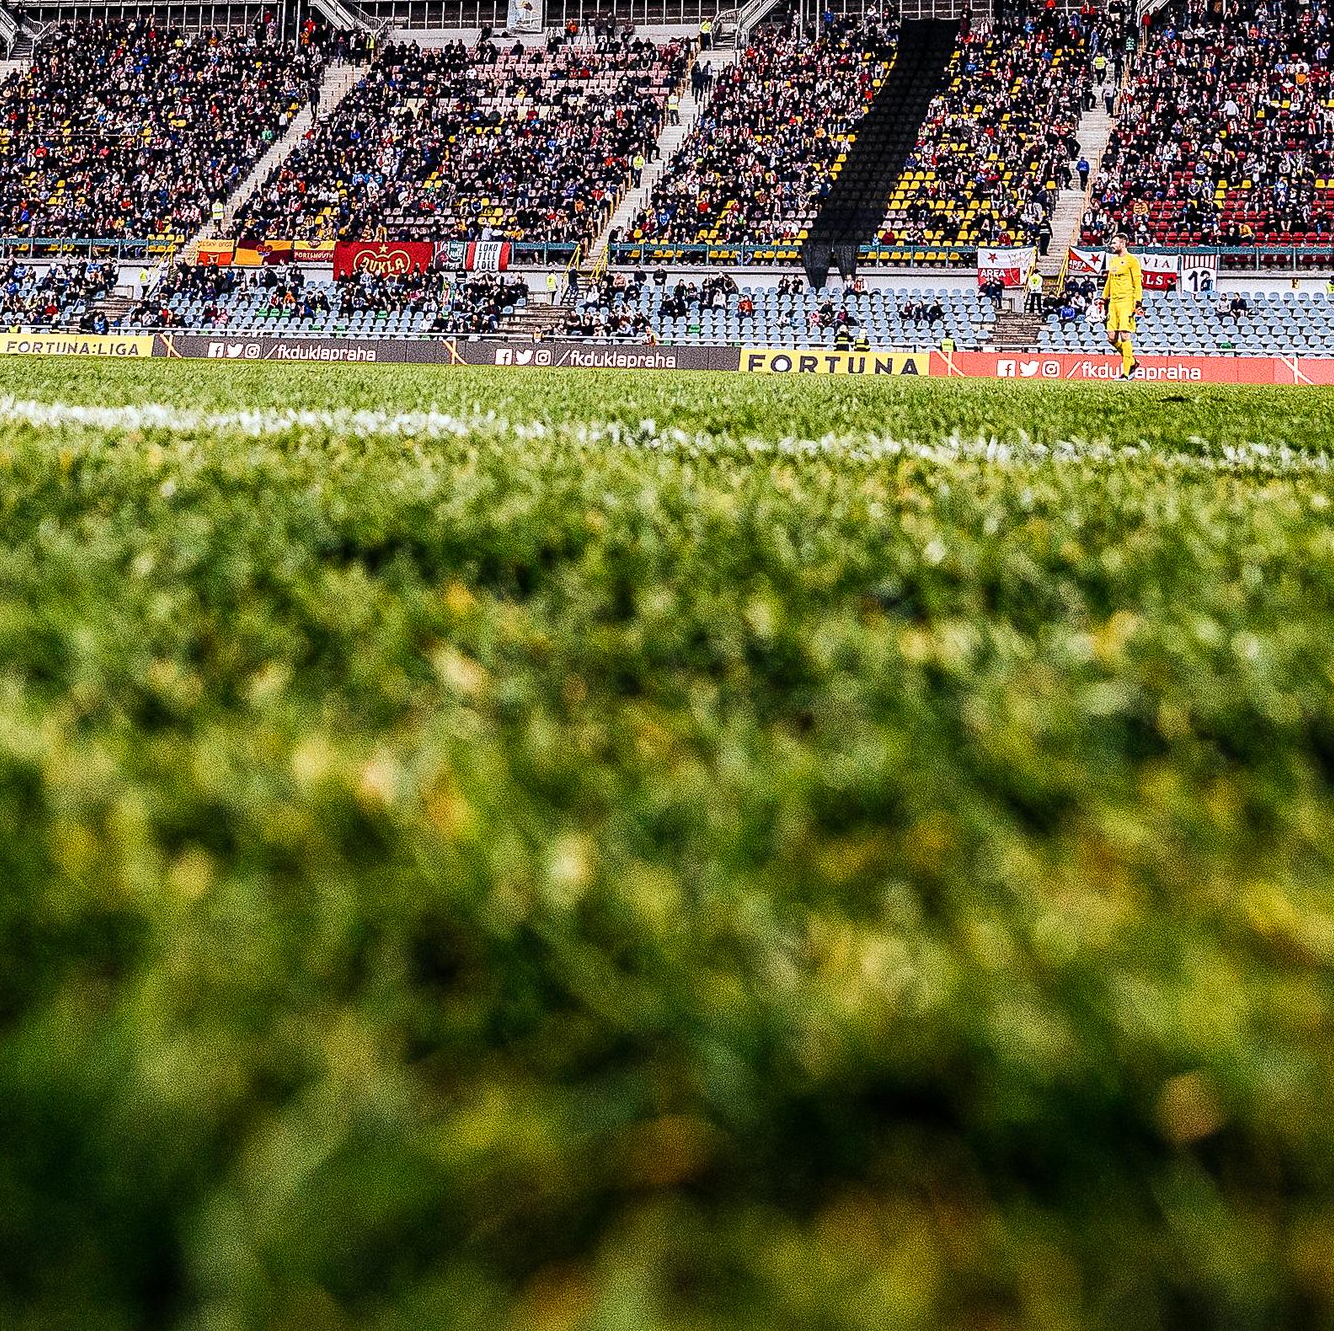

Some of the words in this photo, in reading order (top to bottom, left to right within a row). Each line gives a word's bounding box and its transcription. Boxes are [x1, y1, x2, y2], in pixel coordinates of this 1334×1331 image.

[361, 256, 406, 272] DUKLA
[980, 269, 1006, 277] AREA
[265, 343, 376, 362] /fkduklapraha
[555, 350, 676, 369] /fkduklapraha
[748, 355, 917, 375] FORTUNA
